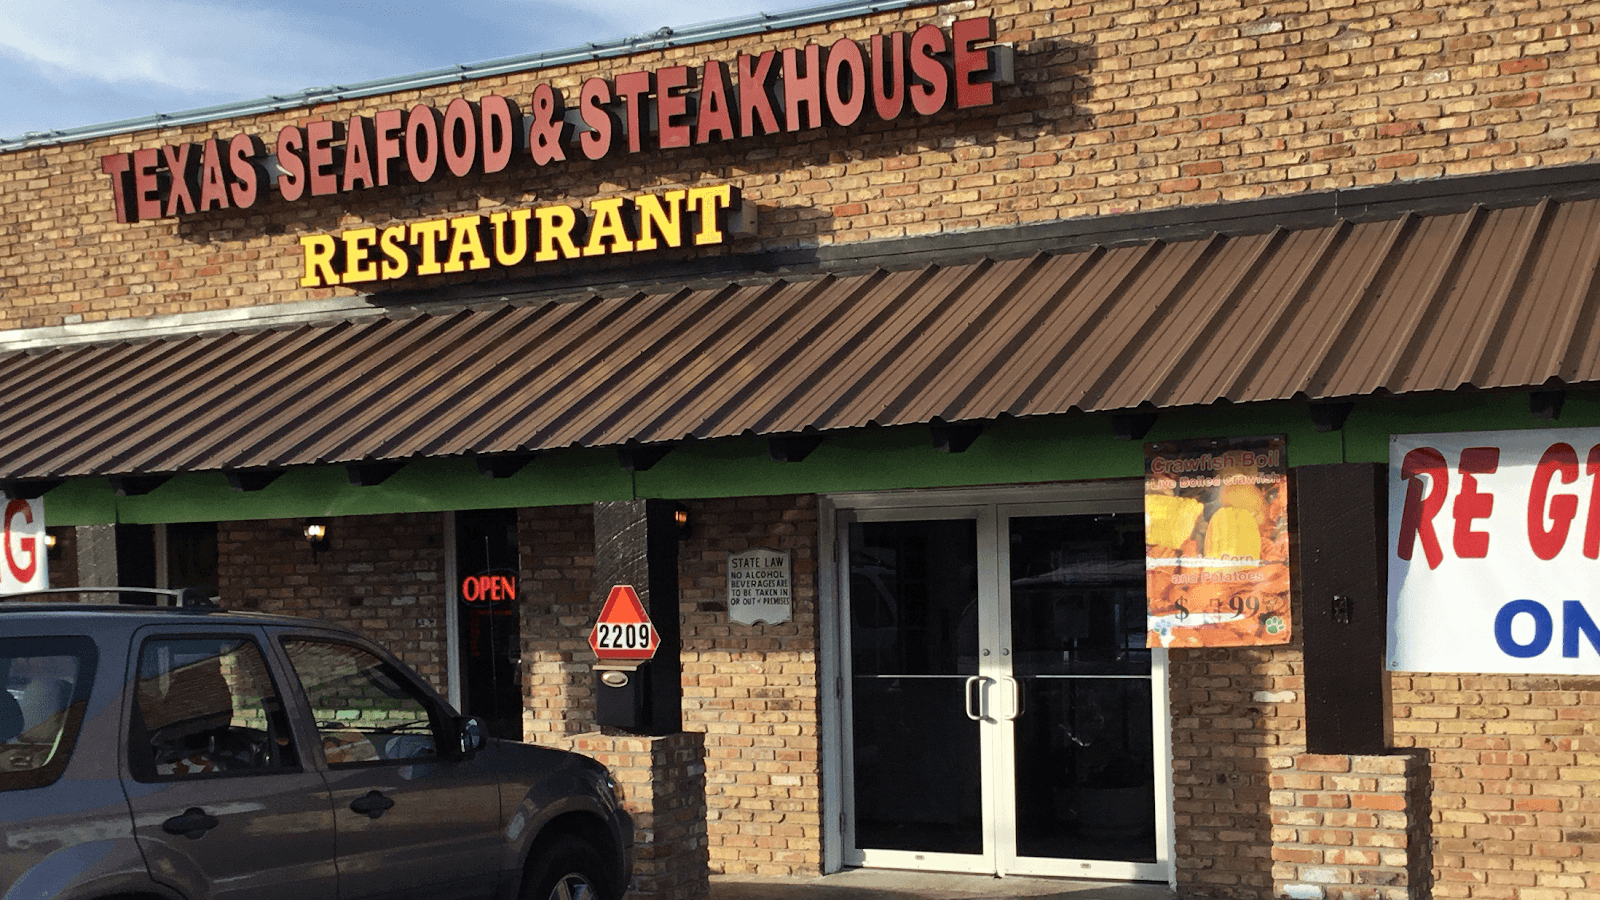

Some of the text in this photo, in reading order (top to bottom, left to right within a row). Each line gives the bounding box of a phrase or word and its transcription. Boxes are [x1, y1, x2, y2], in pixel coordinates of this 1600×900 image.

[101, 17, 995, 224] TEXAS SEAFOOD & STEAKHOUSE
[300, 184, 731, 288] RESTAURANT
[1150, 449, 1280, 474] Crawfish Boil
[1179, 475, 1221, 489] Boiled
[1223, 471, 1280, 486] Crawfish
[1397, 446, 1501, 571] RE
[0, 498, 37, 584] G
[731, 557, 784, 569] STATE LAW
[730, 570, 784, 579] NO ALCOHOL
[730, 579, 789, 588] BEVERAGES ARE
[1171, 570, 1265, 585] and Potatoes
[462, 575, 516, 602] OPEN
[731, 588, 788, 597] TO BE TAKEN IN
[743, 597, 757, 605] OUT
[599, 624, 650, 649] 2209
